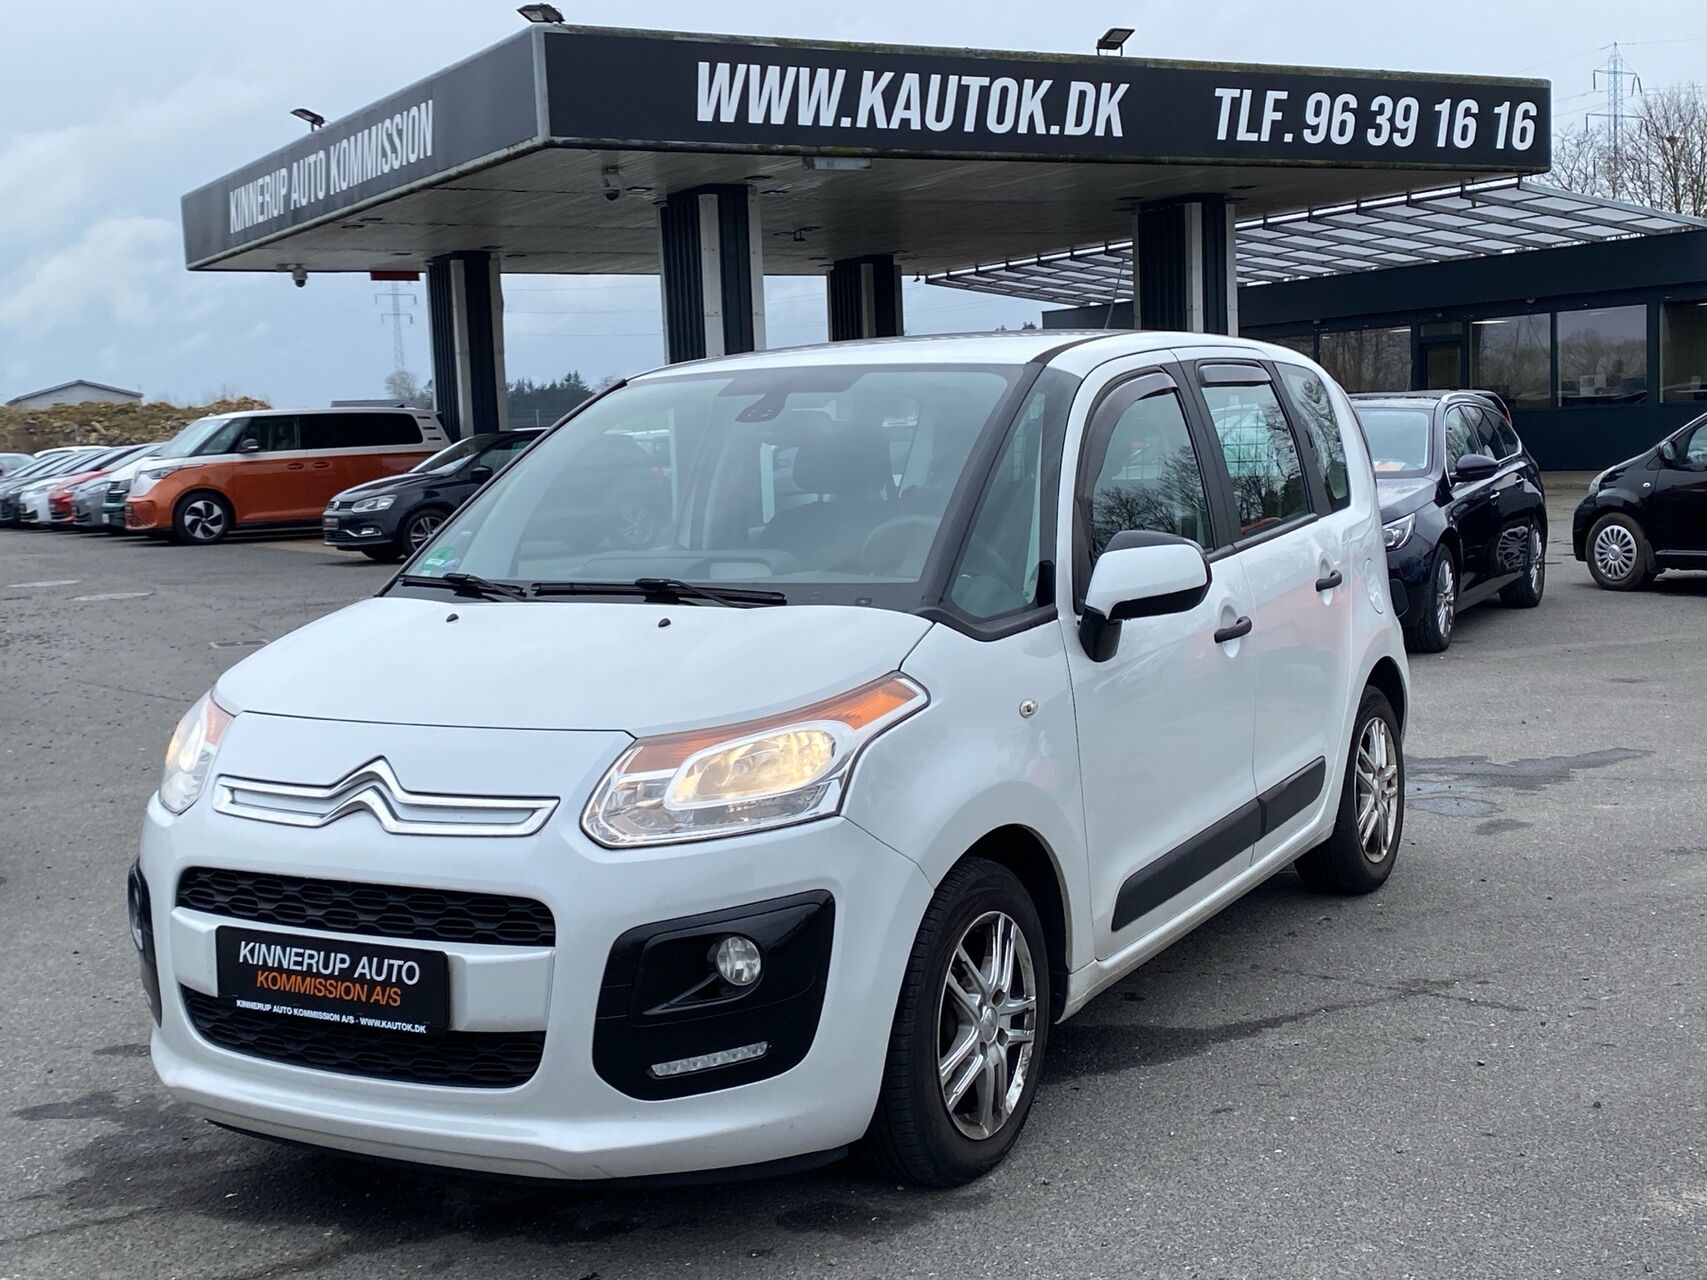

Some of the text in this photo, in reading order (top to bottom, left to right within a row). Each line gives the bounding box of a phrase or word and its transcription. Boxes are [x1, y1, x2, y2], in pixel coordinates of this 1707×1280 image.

[697, 61, 1131, 138] WWW.KAUTOK.DK
[1214, 87, 1538, 151] TLF. 96 39 16 16
[229, 99, 434, 234] KINNERUP AUTO KOMMISSION
[239, 941, 420, 985] KINNERUP AUTO
[257, 971, 401, 1006] KOMMISSION A/S
[236, 999, 272, 1012] KINNERUP
[272, 1005, 293, 1015] AUTO
[293, 1007, 341, 1023] KOMMISSION
[341, 1014, 355, 1024] A/S
[359, 1016, 427, 1034] WWW.KAUTOK.DK
